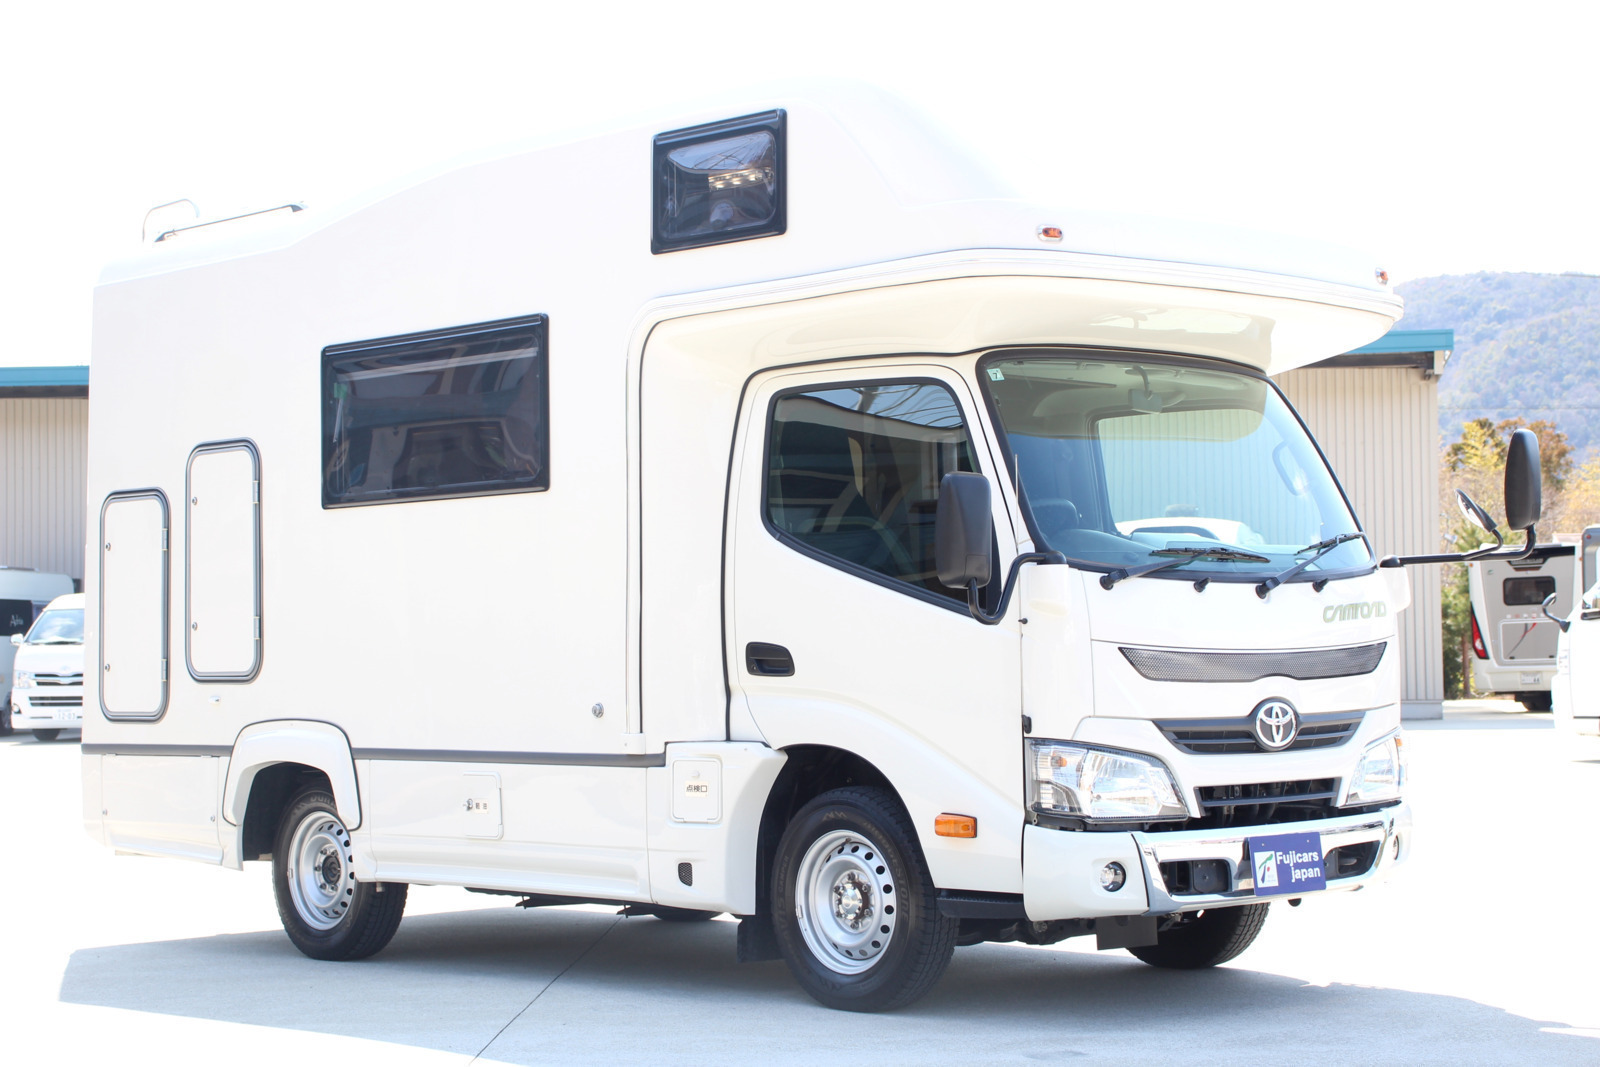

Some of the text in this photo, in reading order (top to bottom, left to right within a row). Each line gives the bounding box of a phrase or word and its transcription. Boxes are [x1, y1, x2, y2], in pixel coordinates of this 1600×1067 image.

[686, 784, 708, 793] 点検口
[1276, 850, 1319, 867] Fujicars
[1291, 866, 1321, 883] japan
